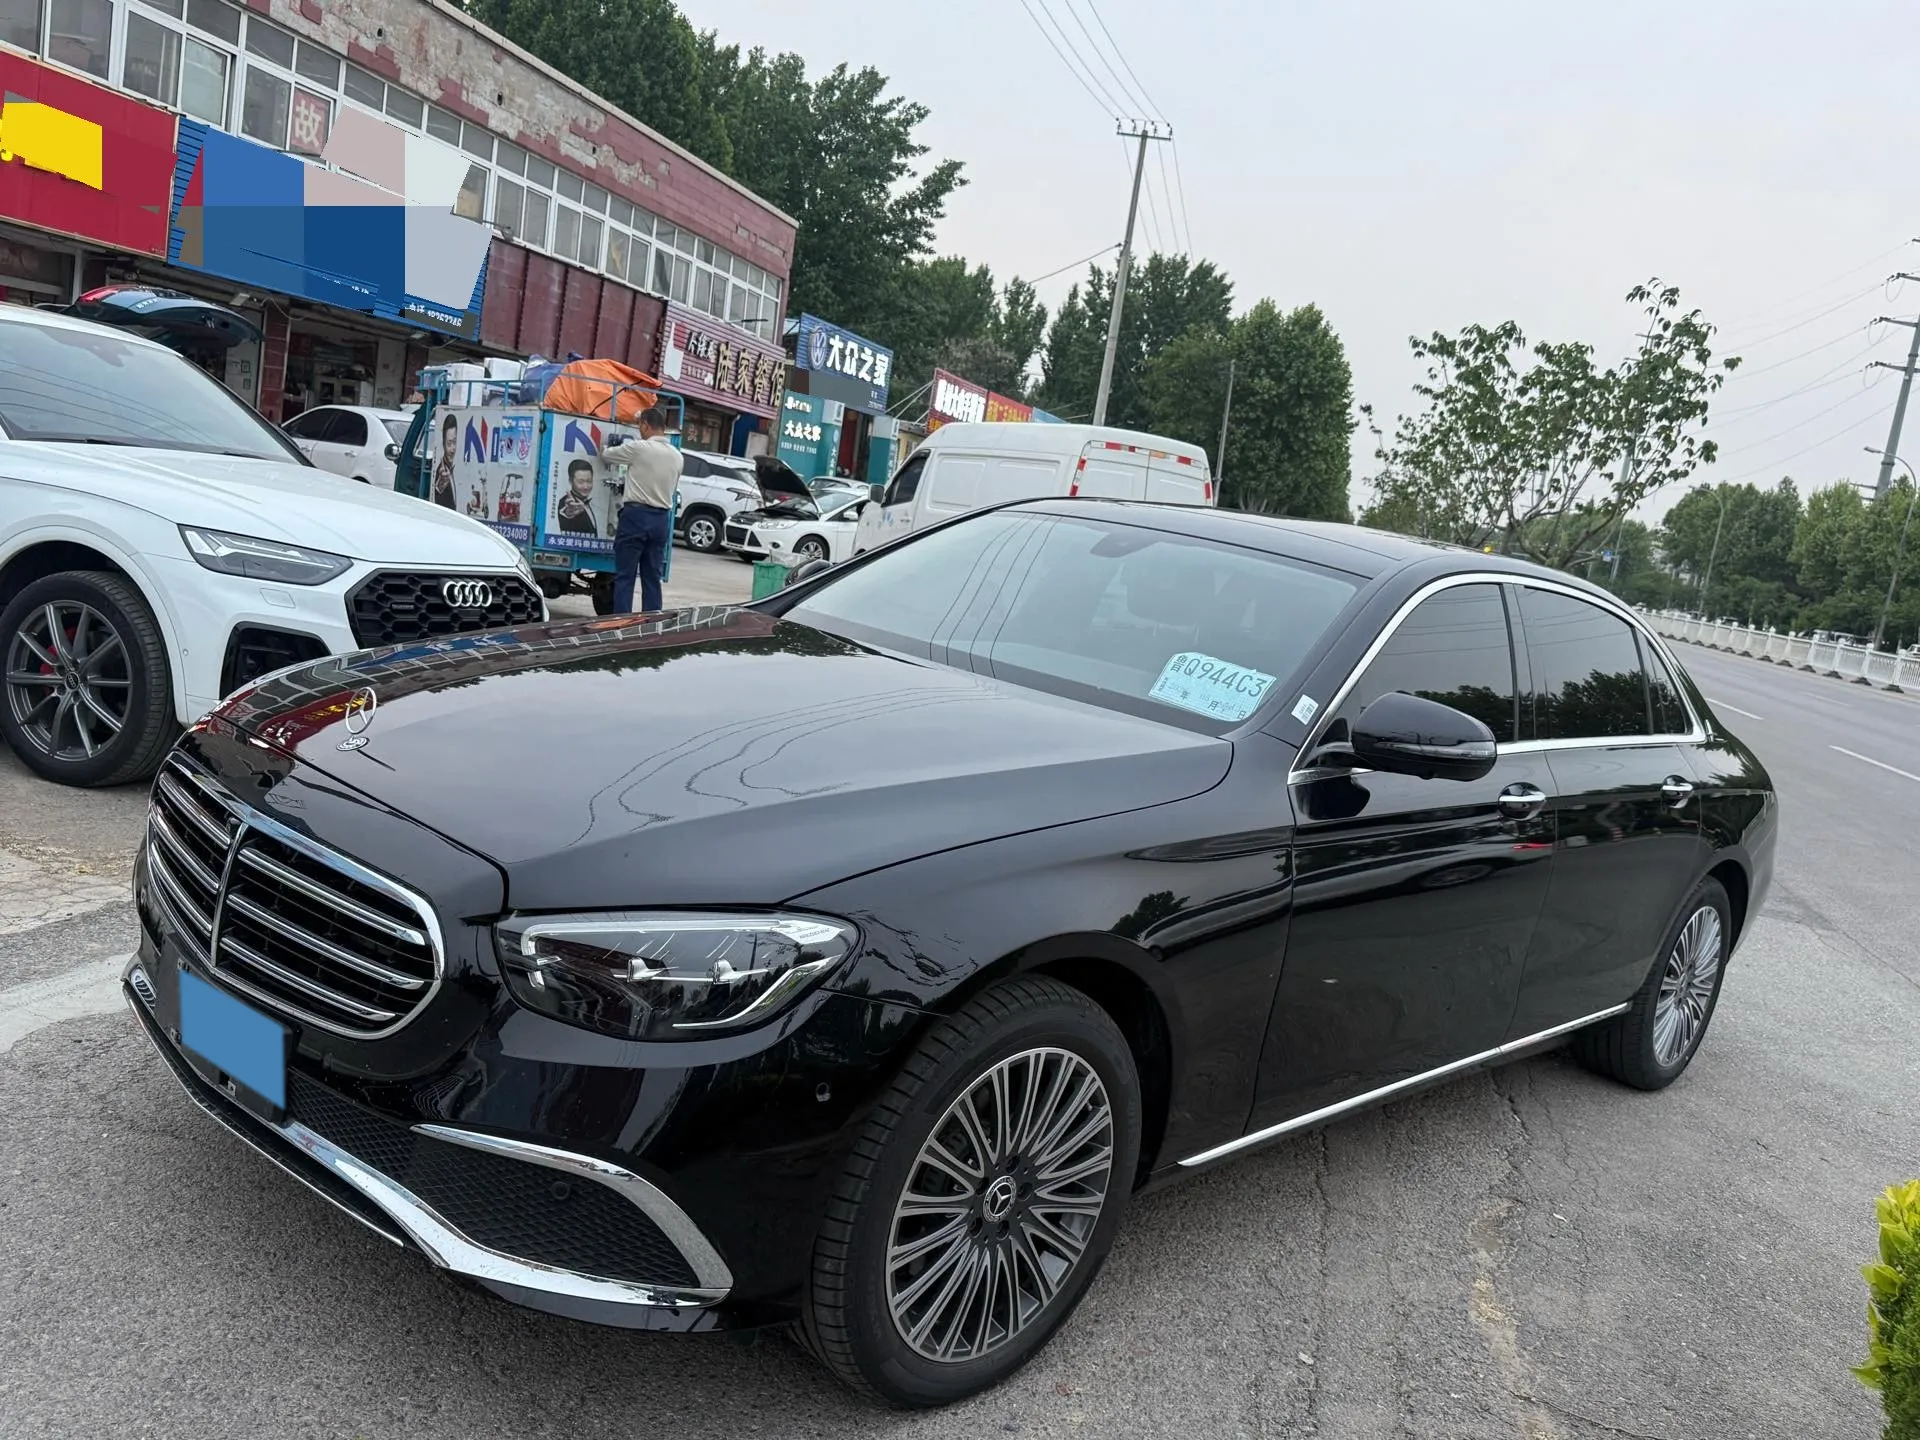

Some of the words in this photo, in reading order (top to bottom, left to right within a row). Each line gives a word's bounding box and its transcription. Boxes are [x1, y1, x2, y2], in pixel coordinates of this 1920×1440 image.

[295, 100, 321, 148] 故
[827, 335, 889, 388] 大众之家
[784, 419, 821, 442] 大众之家
[1170, 655, 1267, 697] 鲁Q944C3
